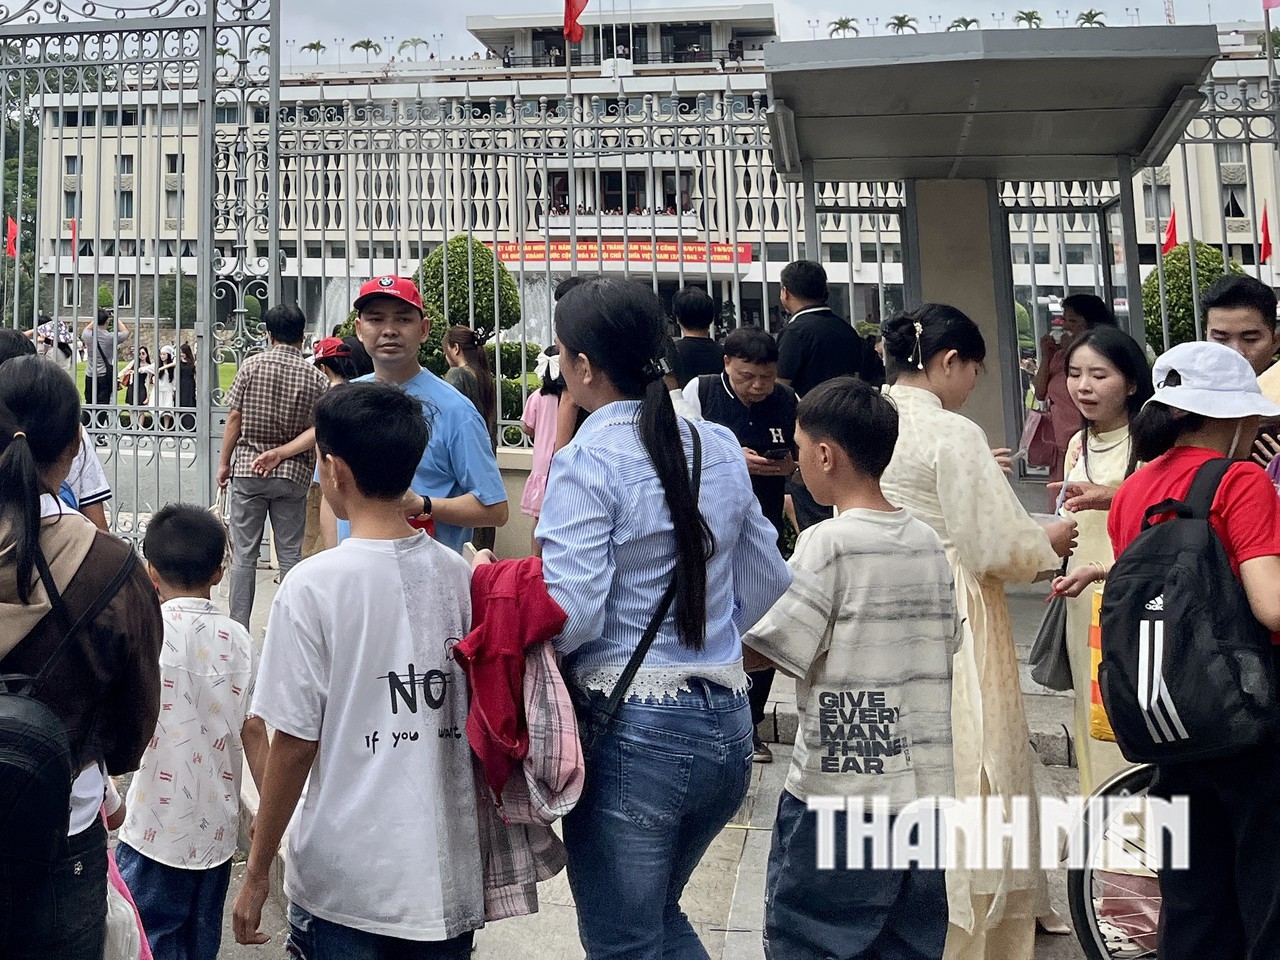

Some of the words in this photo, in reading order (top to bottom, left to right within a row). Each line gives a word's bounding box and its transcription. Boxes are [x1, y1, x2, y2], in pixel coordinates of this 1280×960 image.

[769, 428, 785, 443] H
[389, 663, 447, 714] NO
[819, 691, 886, 708] GIVE
[392, 731, 419, 748] you
[820, 724, 890, 740] MAN
[821, 756, 885, 774] EAR
